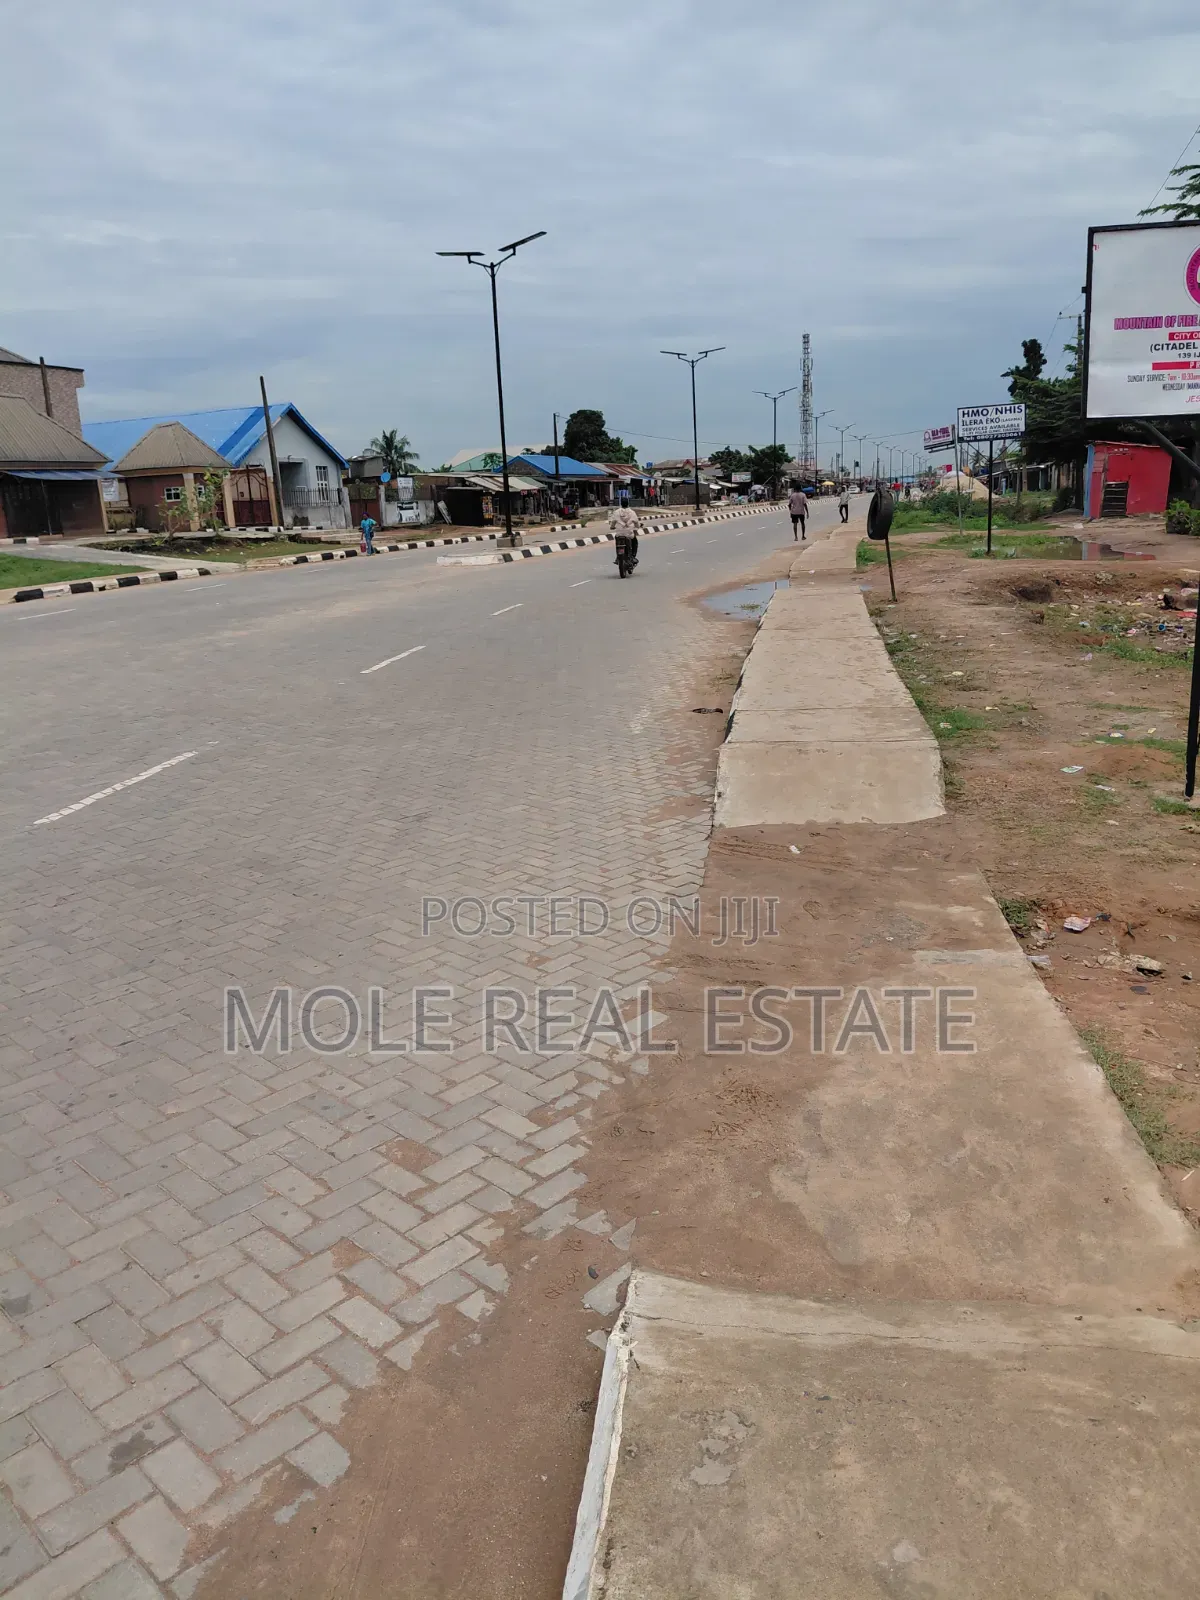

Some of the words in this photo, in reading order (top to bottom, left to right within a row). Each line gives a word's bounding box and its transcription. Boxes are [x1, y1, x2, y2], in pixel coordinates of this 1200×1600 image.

[1114, 316, 1163, 330] MOUNTAIN
[1164, 315, 1176, 328] OF
[1177, 314, 1198, 327] FIRE
[1150, 342, 1198, 353] (CITADEL
[1127, 375, 1145, 383] SUNDAY
[1162, 383, 1186, 391] WEDNESDAY
[962, 405, 1023, 418] HMO/NHIS
